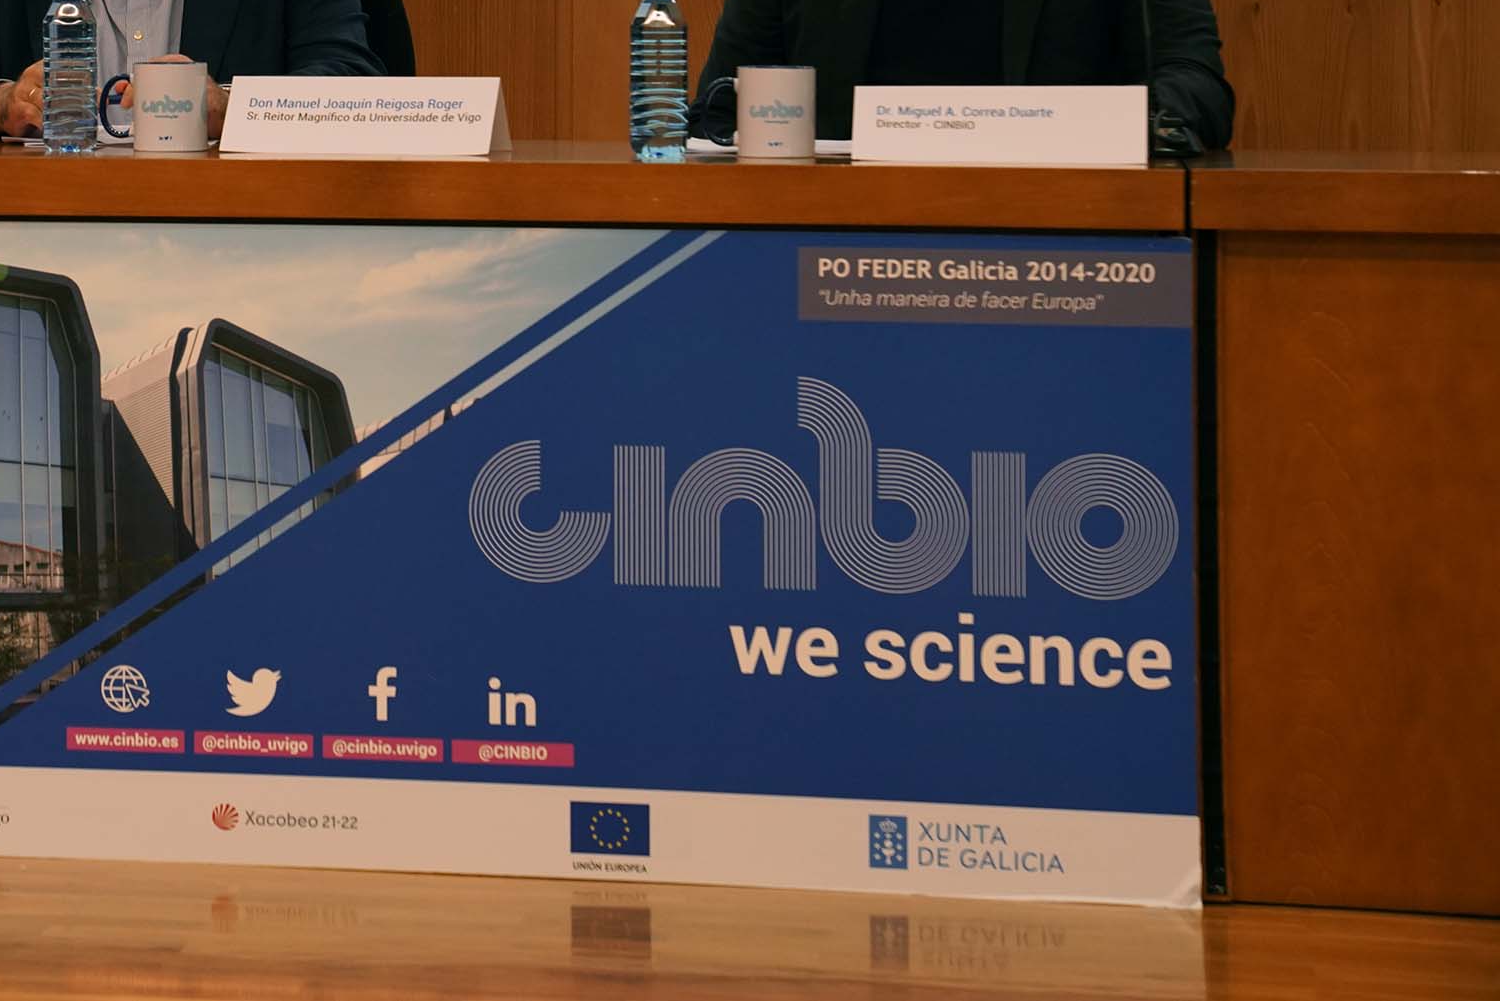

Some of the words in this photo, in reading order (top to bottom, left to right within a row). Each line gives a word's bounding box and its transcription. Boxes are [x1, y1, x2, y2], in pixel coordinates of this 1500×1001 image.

[249, 98, 272, 108] Don
[276, 98, 320, 109] Manuel
[324, 98, 372, 111] Joaquín
[376, 99, 423, 112] Reigosa
[427, 99, 463, 112] Roger
[876, 105, 891, 116] Dr.
[898, 106, 942, 118] Miguel
[946, 106, 956, 117] A.
[962, 106, 1005, 117] Correa
[1009, 106, 1054, 118] Duarte
[247, 111, 259, 121] Sr.
[264, 112, 294, 121] Reitor
[298, 112, 350, 124] Magnífico
[353, 112, 366, 122] da
[369, 112, 438, 123] Universidade
[441, 113, 454, 123] de
[458, 113, 481, 124] Vigo
[876, 119, 921, 129] Director
[933, 120, 975, 130] CINBIO
[818, 258, 850, 278] PO
[858, 259, 932, 280] FEDER
[939, 259, 1018, 281] Galicia
[1026, 261, 1155, 284] 2014-2020
[877, 290, 949, 309] maneira
[954, 290, 977, 309] de
[981, 290, 1027, 310] facer
[729, 623, 839, 677] we
[864, 612, 1172, 690] science
[75, 731, 179, 749] www.cinbio.es
[202, 735, 309, 755] @cinbio_uvigo
[332, 738, 438, 759] @cinbio.uvigo
[478, 743, 548, 762] @CINBIO
[245, 809, 318, 828] Xacobeo
[918, 821, 1007, 845] XUNTA
[572, 860, 602, 872] UNIÓN
[604, 862, 648, 873] EUROPEA
[918, 847, 949, 868] DE
[959, 849, 1065, 873] GALICIA
